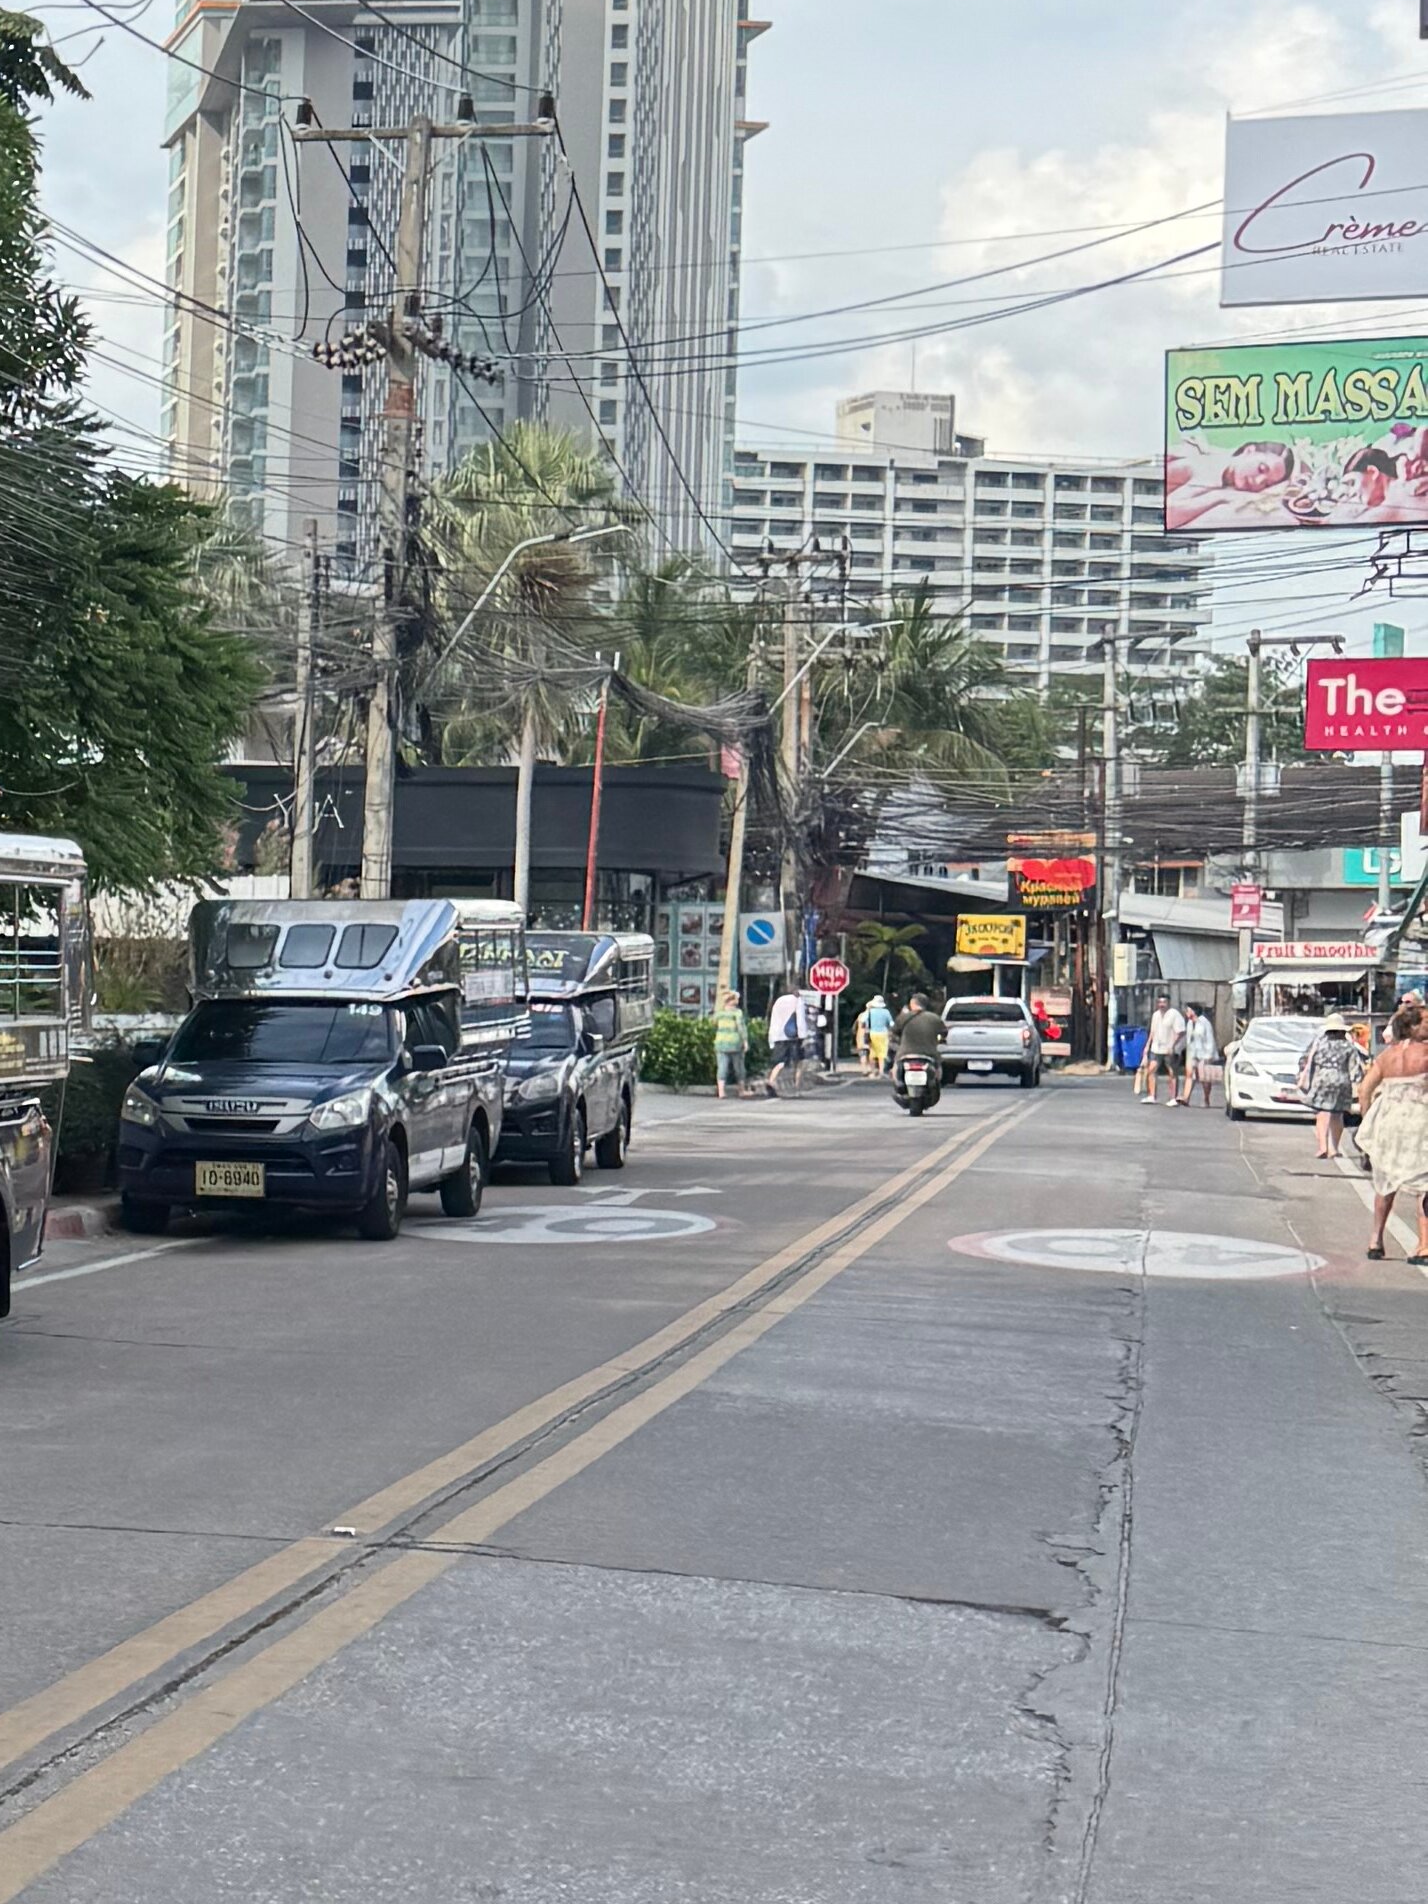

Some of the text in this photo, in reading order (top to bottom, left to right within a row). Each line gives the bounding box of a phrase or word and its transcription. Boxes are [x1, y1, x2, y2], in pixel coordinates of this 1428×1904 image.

[1175, 372, 1265, 431] SEM
[1317, 673, 1407, 717] The
[1324, 725, 1408, 737] HEALTH
